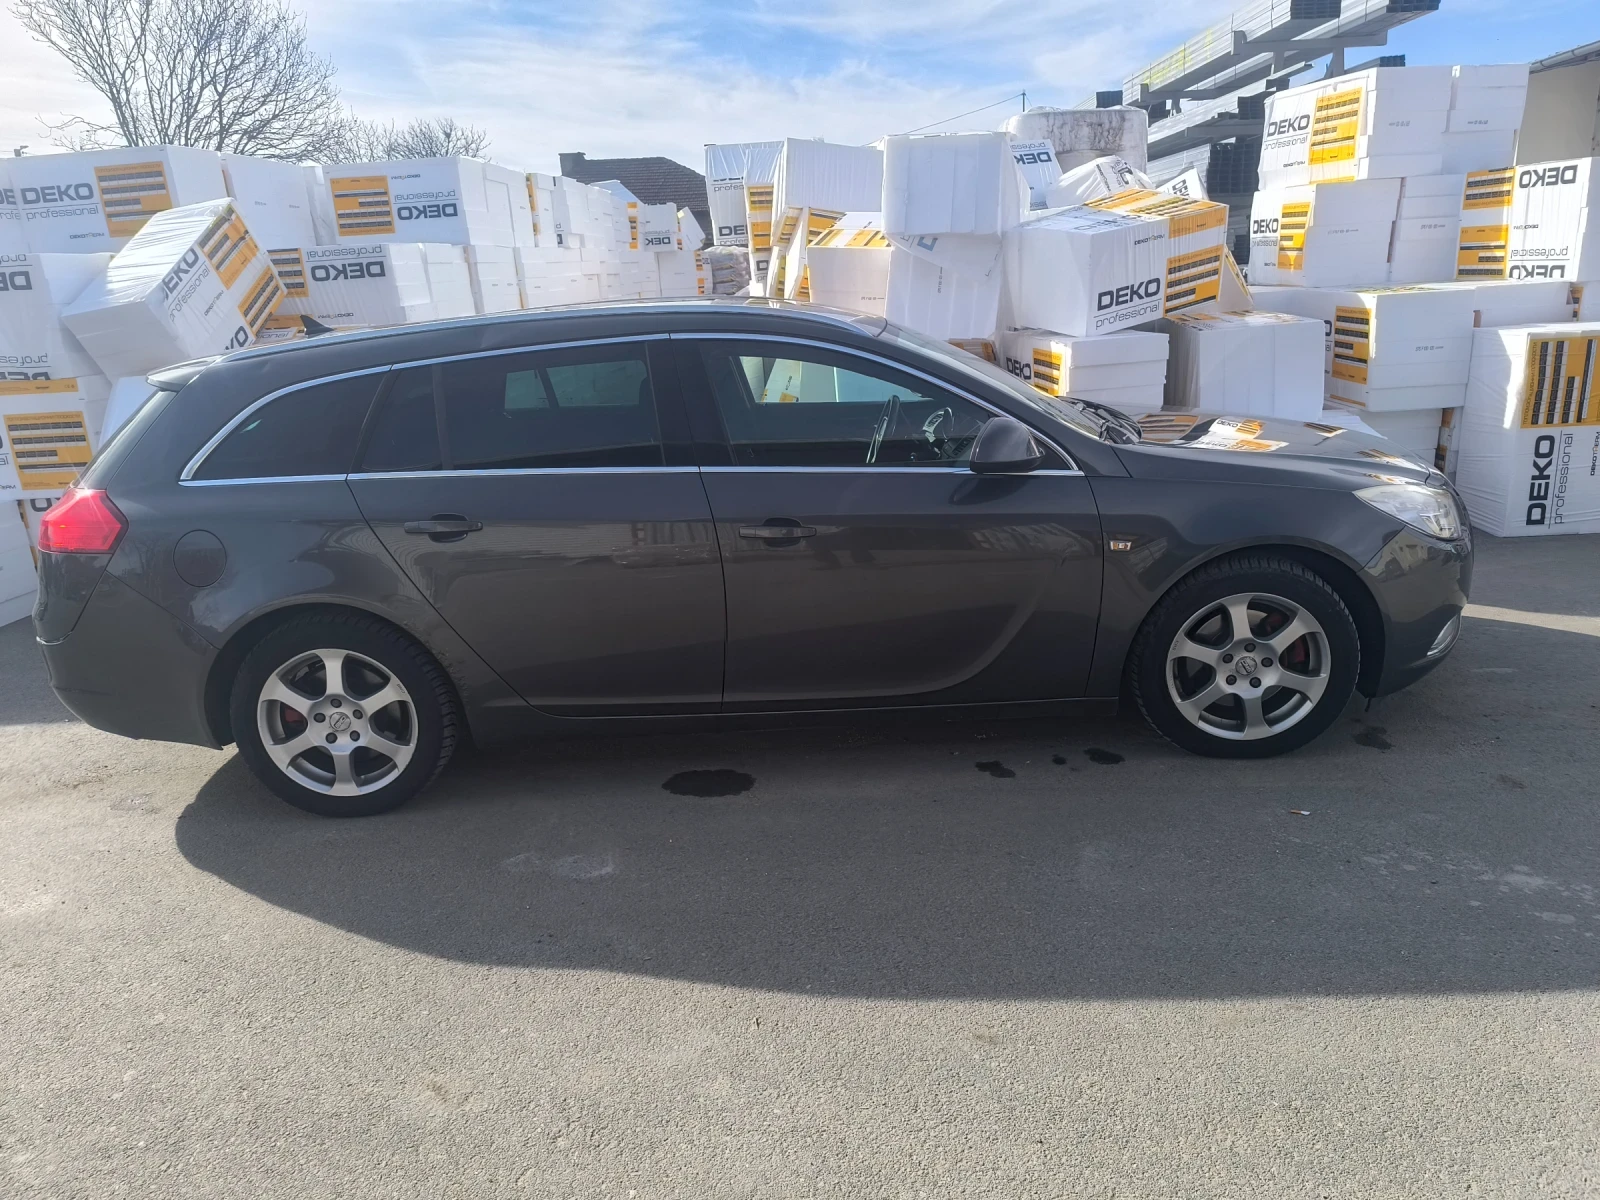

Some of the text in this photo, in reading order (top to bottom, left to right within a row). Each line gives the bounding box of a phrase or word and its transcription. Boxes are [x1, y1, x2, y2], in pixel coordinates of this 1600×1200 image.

[1267, 114, 1310, 137] DEKO
[1519, 165, 1578, 189] DEKO
[21, 182, 94, 205] DEKO
[394, 189, 456, 202] professional
[26, 206, 99, 222] professional
[397, 203, 458, 221] DEKO
[1252, 218, 1279, 235] DEKO
[307, 244, 382, 260] professional
[311, 261, 386, 282] DEKO
[1097, 277, 1161, 311] DEKO
[1095, 301, 1160, 330] professional
[1005, 356, 1031, 380] DEKO
[1525, 434, 1555, 526] DEKO
[1554, 433, 1574, 524] professional
